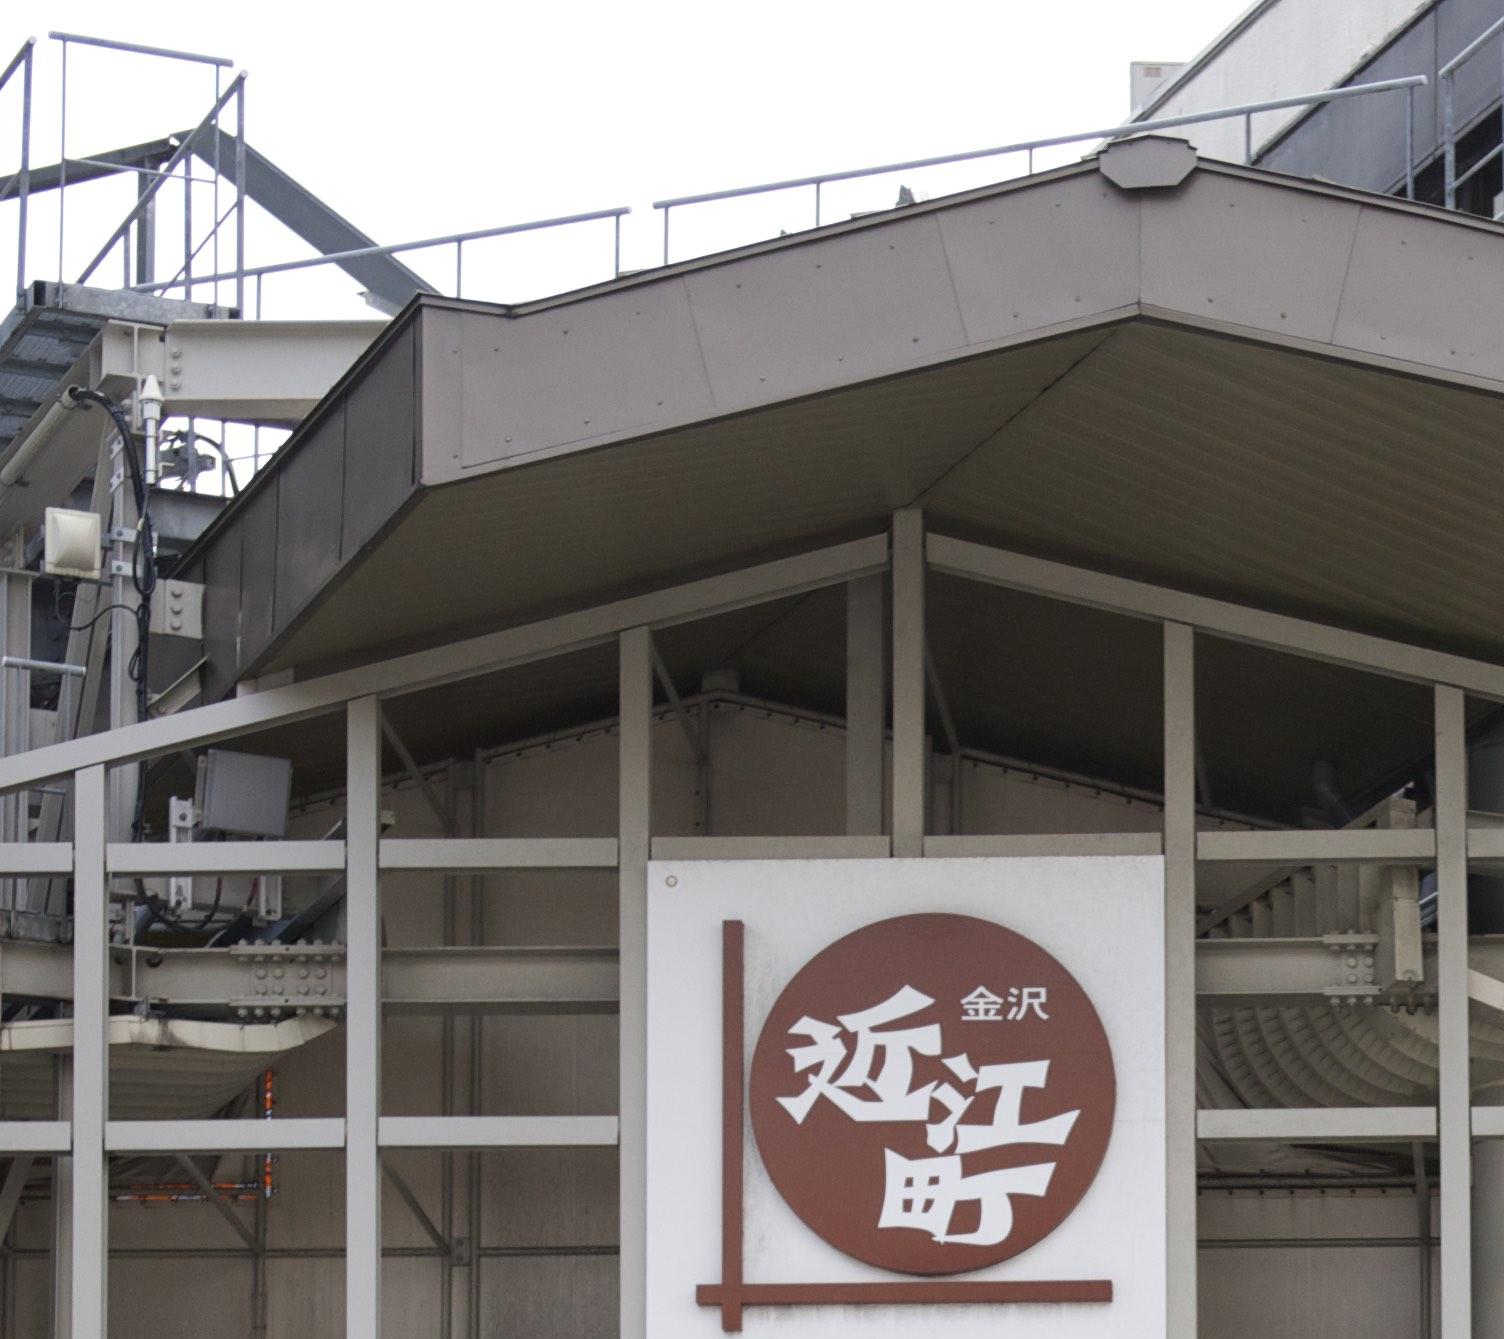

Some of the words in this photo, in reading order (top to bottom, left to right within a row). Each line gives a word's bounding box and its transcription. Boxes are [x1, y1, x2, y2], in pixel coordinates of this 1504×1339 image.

[960, 985, 1050, 1022] 金沢
[775, 984, 1081, 1247] 近江町
